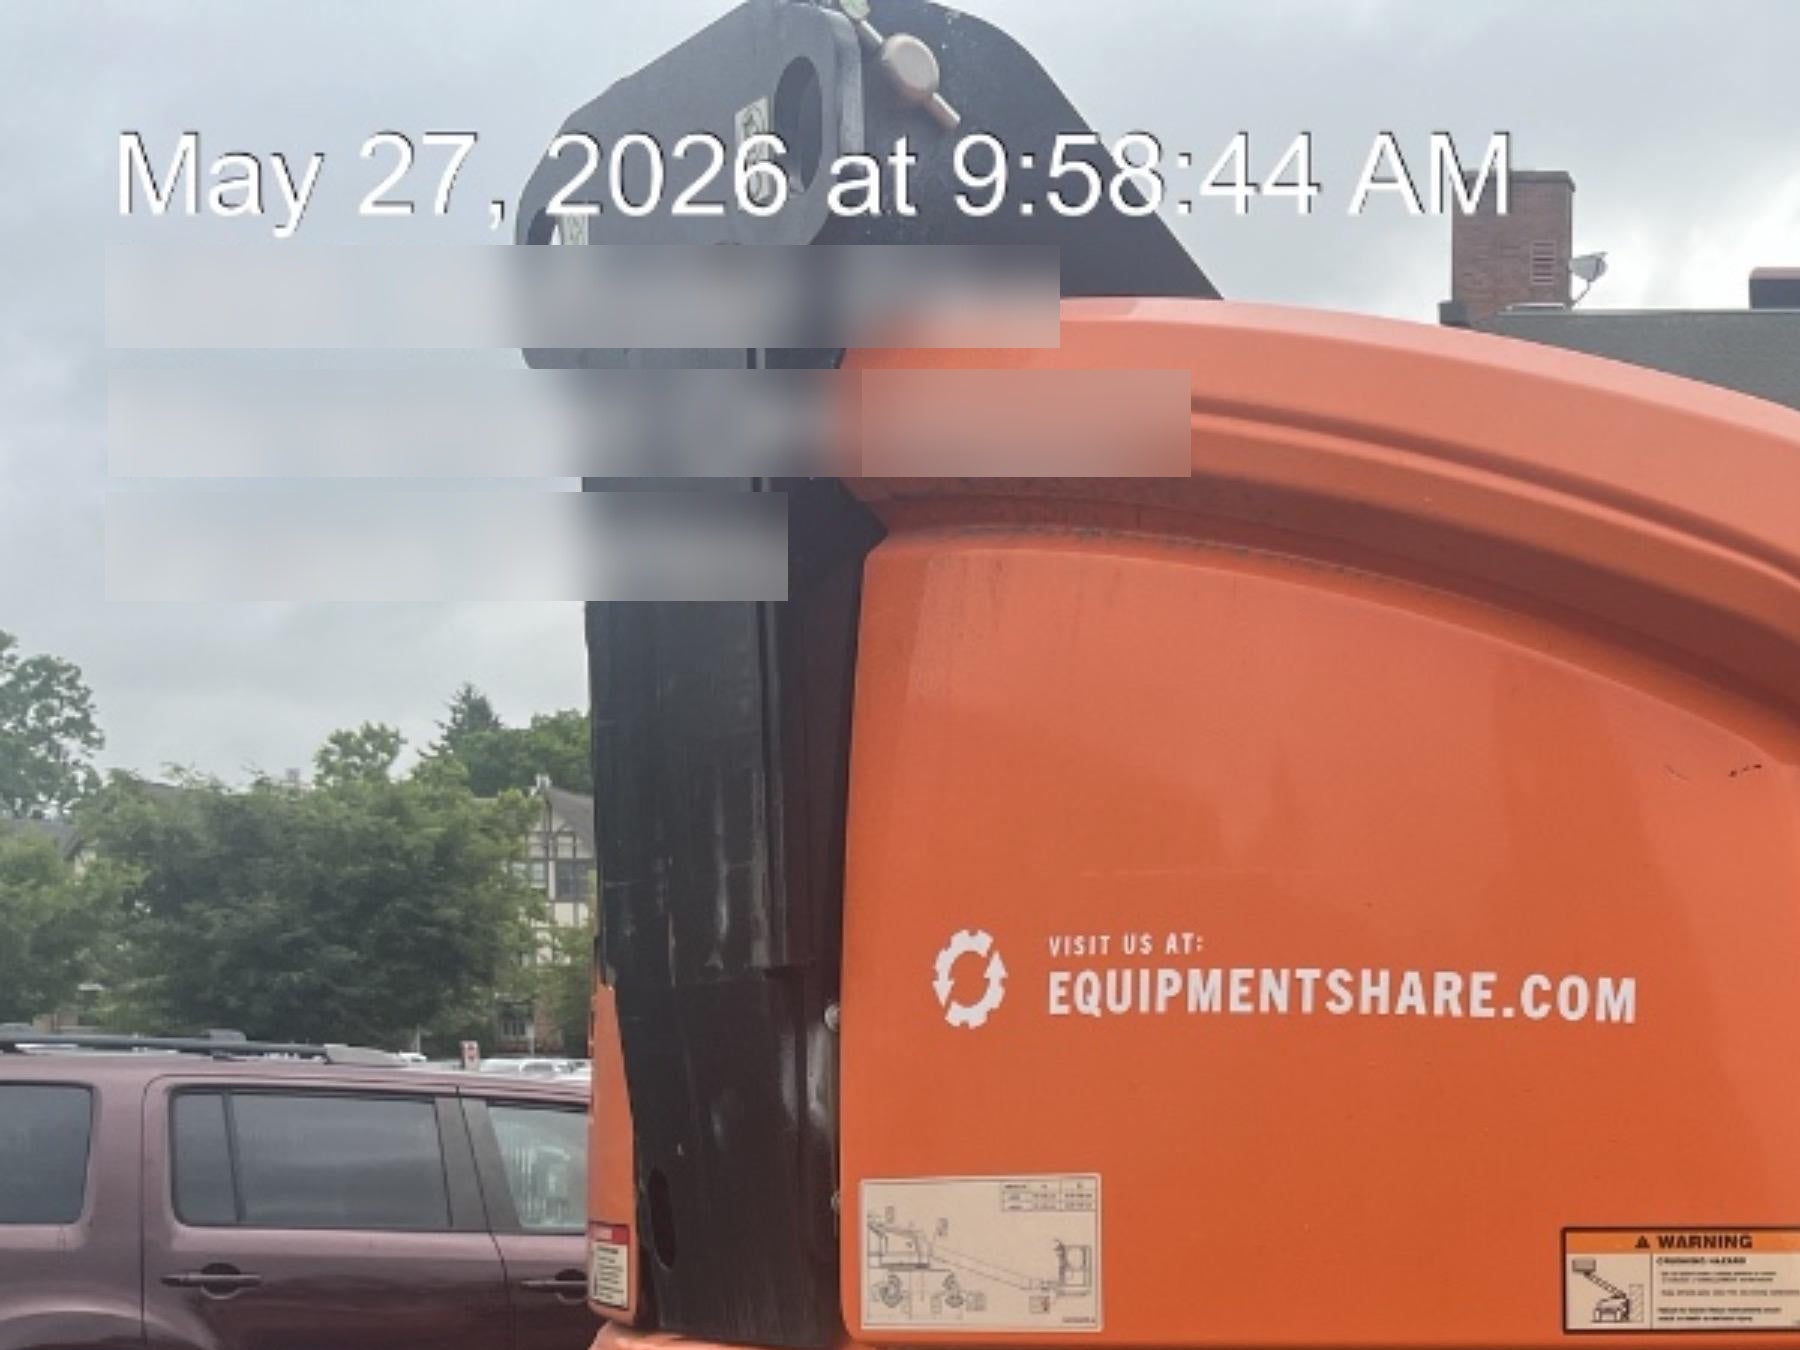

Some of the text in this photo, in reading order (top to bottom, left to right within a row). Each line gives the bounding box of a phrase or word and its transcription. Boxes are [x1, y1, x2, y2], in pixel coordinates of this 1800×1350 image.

[1048, 932, 1205, 957] VISIT US AT:
[1048, 967, 1637, 1024] EQUIPMENTSHARE.COM
[1657, 1234, 1753, 1249] WARNING
